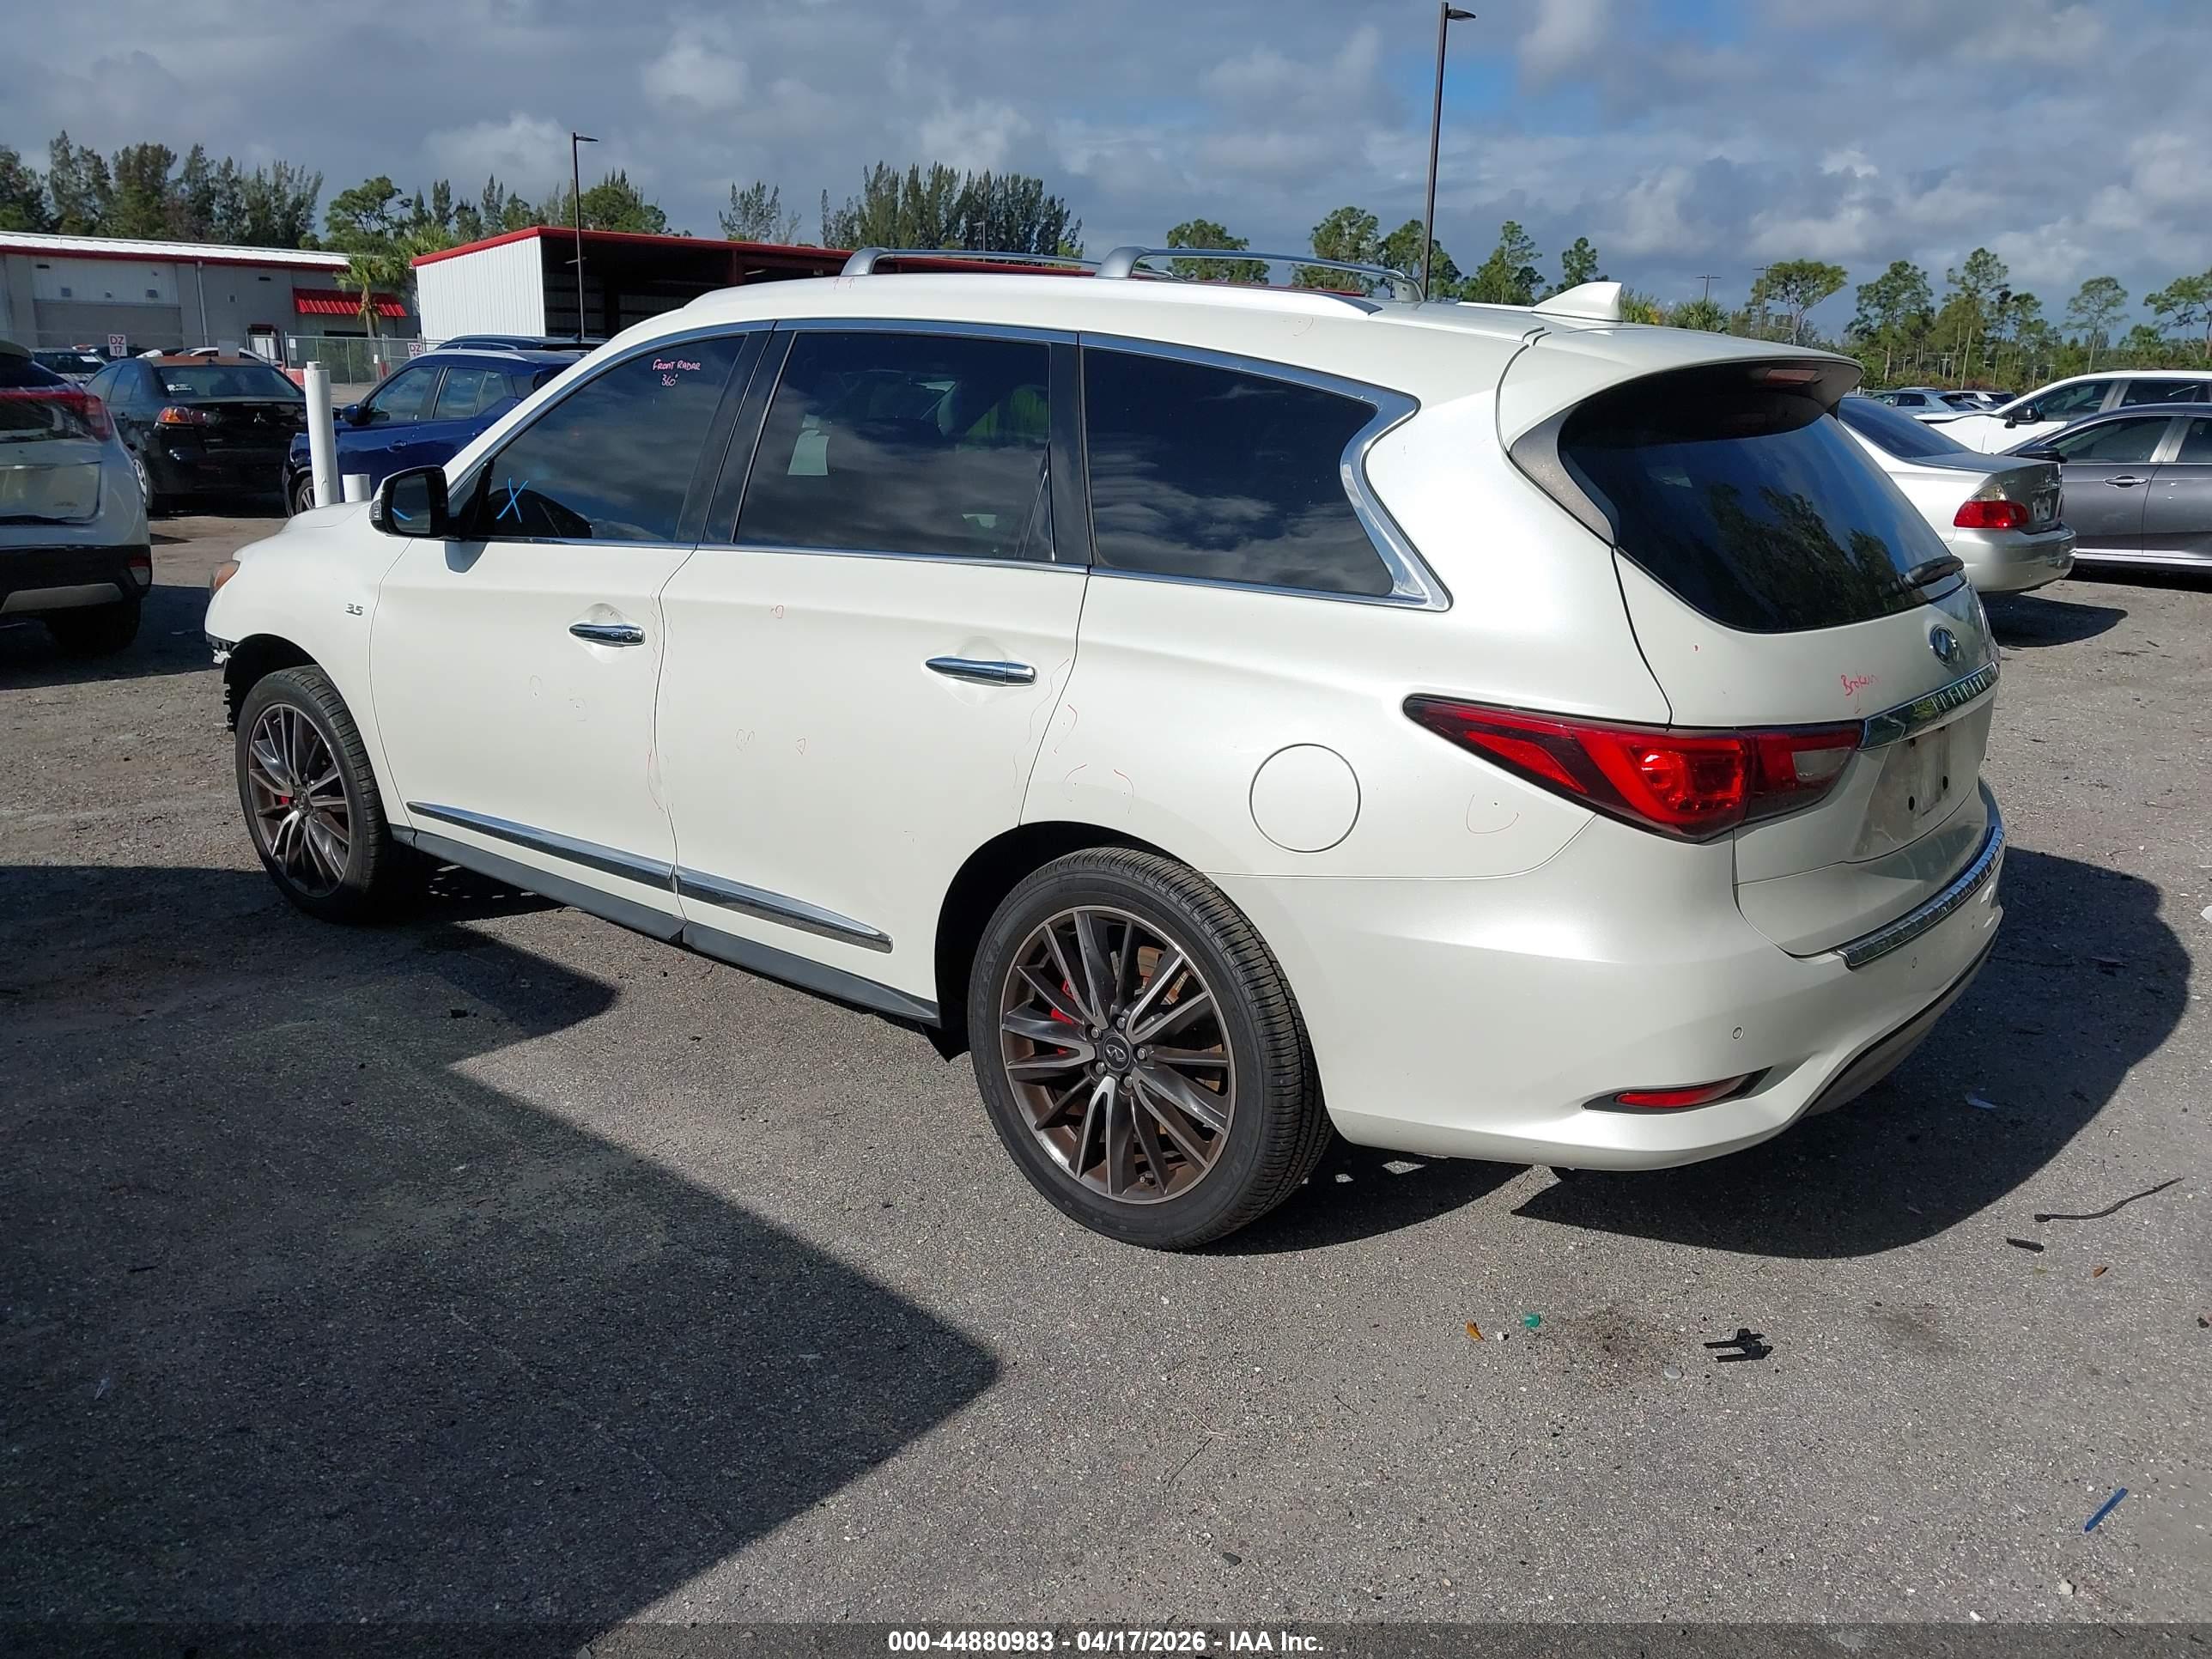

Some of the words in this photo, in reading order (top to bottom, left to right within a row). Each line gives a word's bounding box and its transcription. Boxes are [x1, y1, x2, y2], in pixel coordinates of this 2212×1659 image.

[110, 336, 125, 345] DZ
[113, 346, 122, 355] 17
[410, 344, 422, 353] DZ
[677, 360, 701, 371] RADAR
